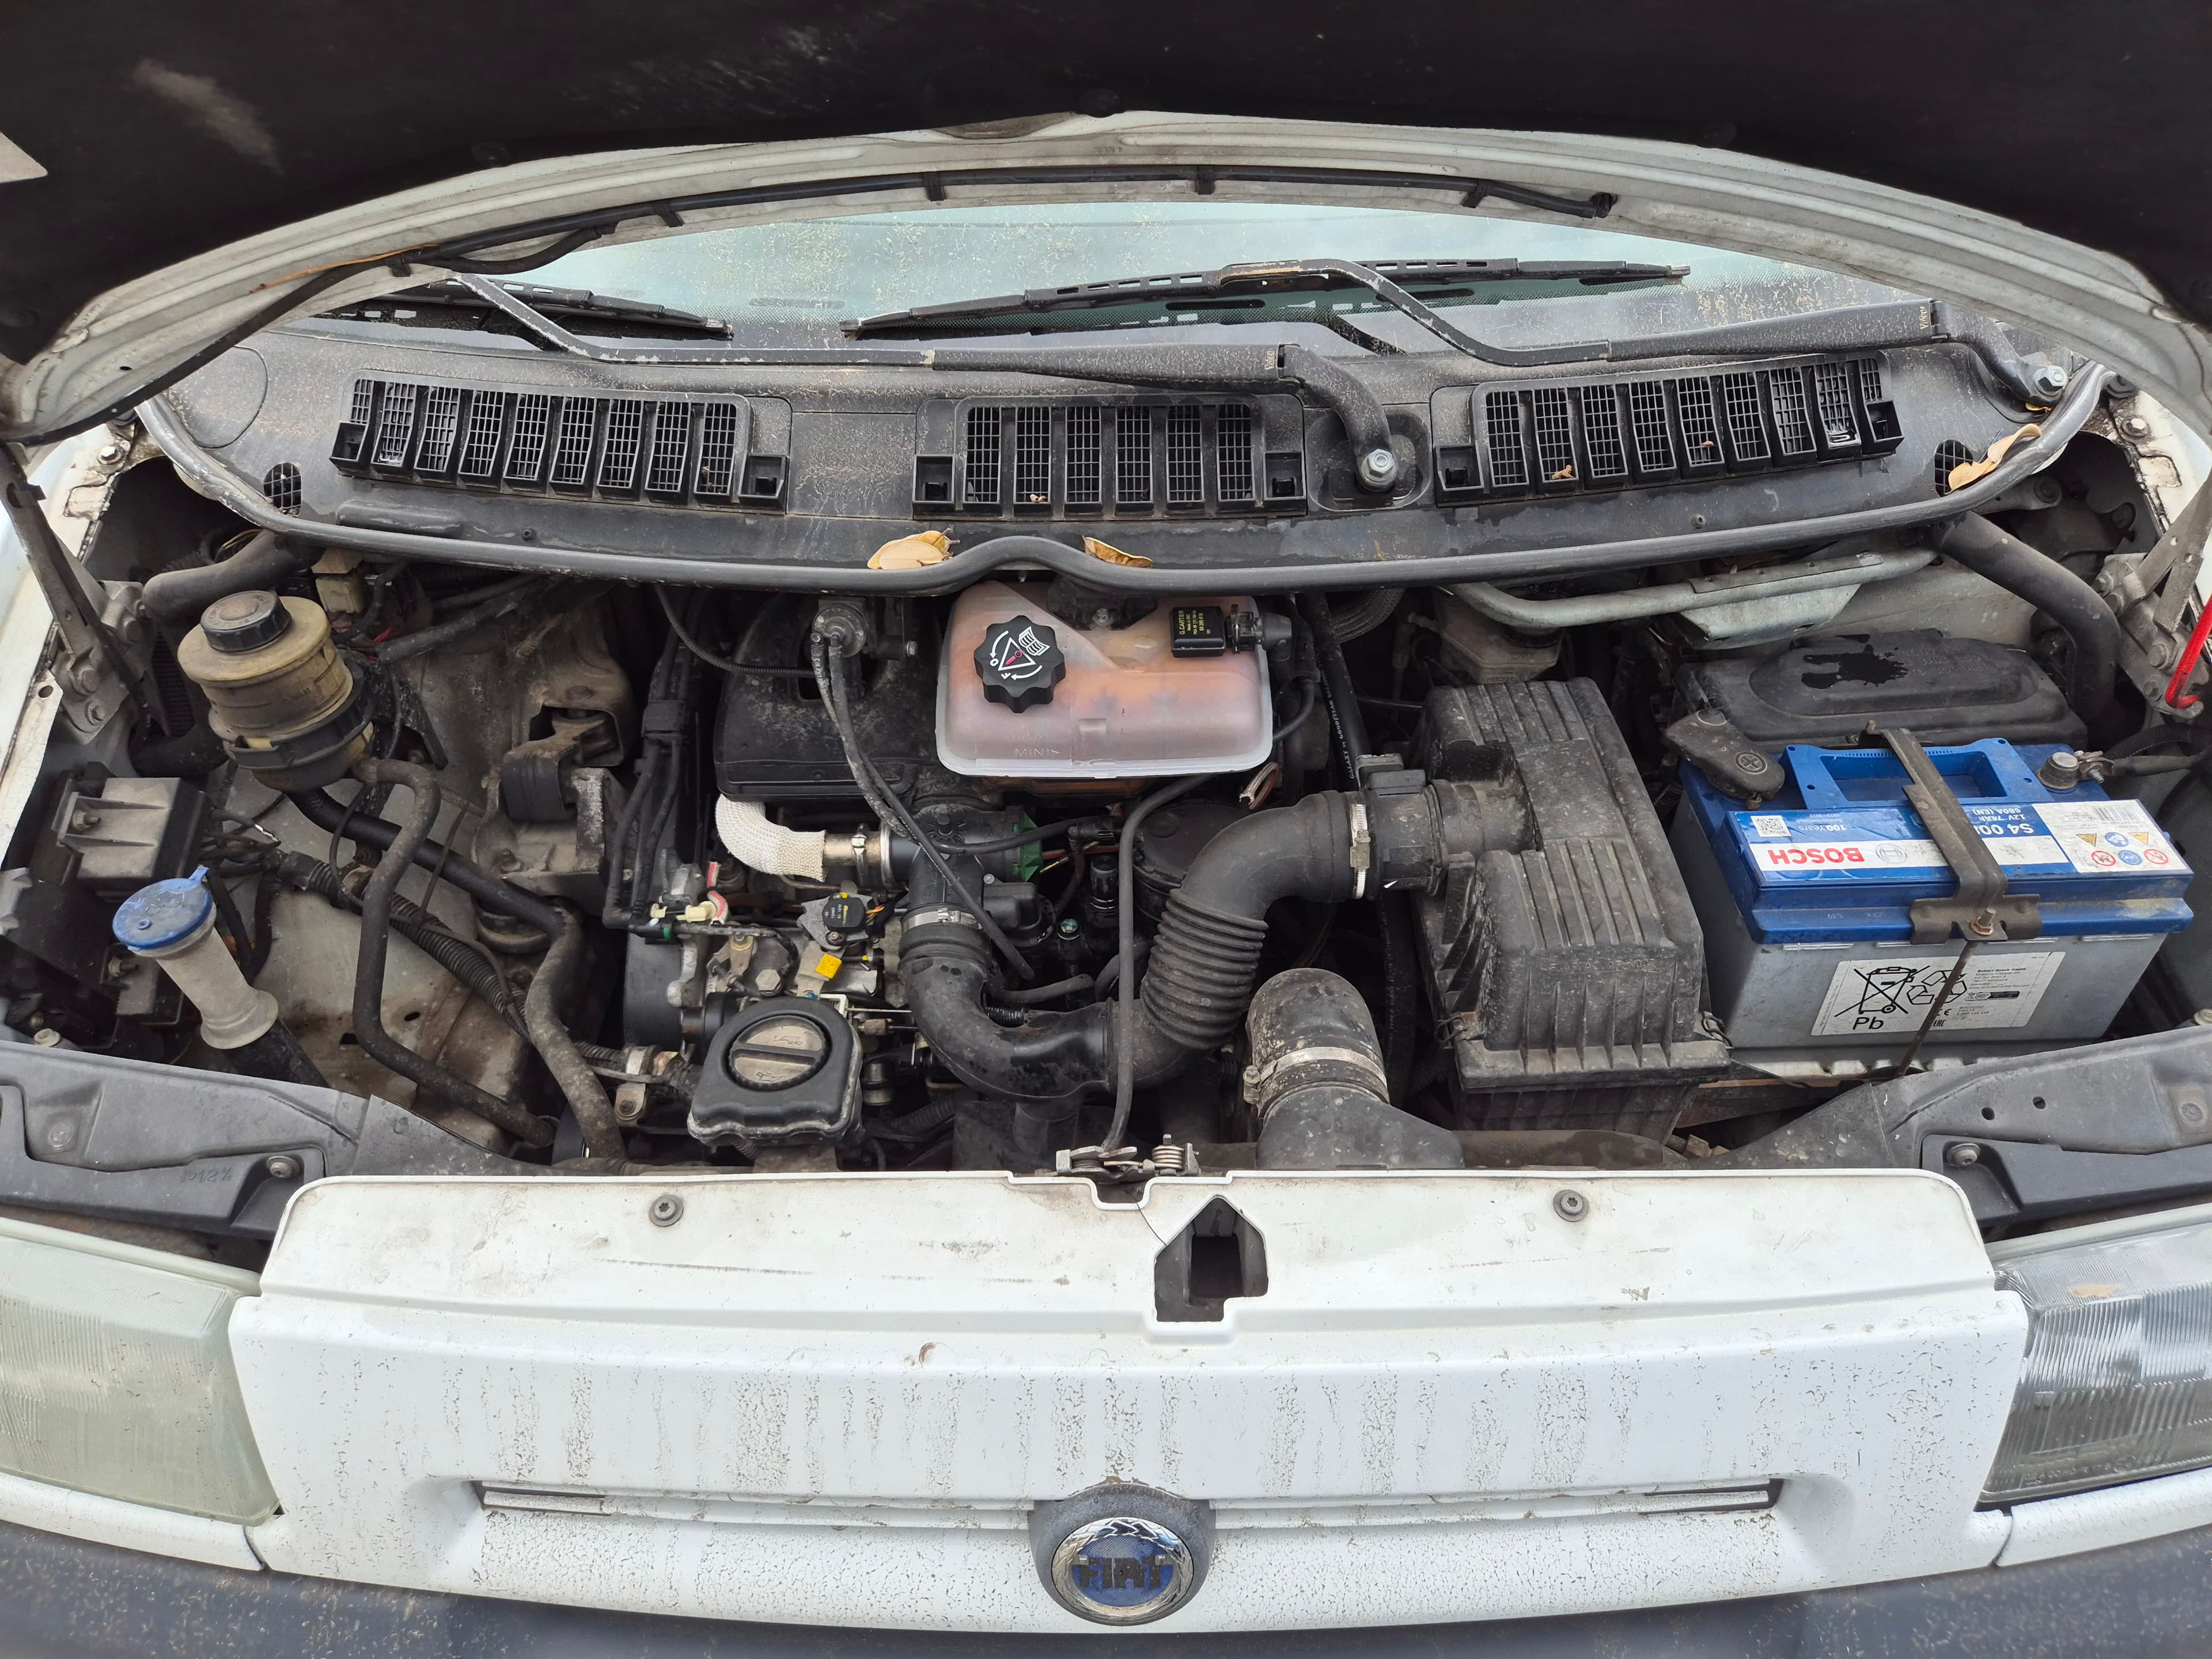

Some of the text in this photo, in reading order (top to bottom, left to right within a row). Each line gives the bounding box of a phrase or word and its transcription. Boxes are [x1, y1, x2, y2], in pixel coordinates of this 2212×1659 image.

[2006, 823, 2034, 835] S4
[1767, 847, 1865, 865] BOSCH
[1853, 1016, 1884, 1030] Pb
[1077, 1555, 1162, 1589] FIAT
